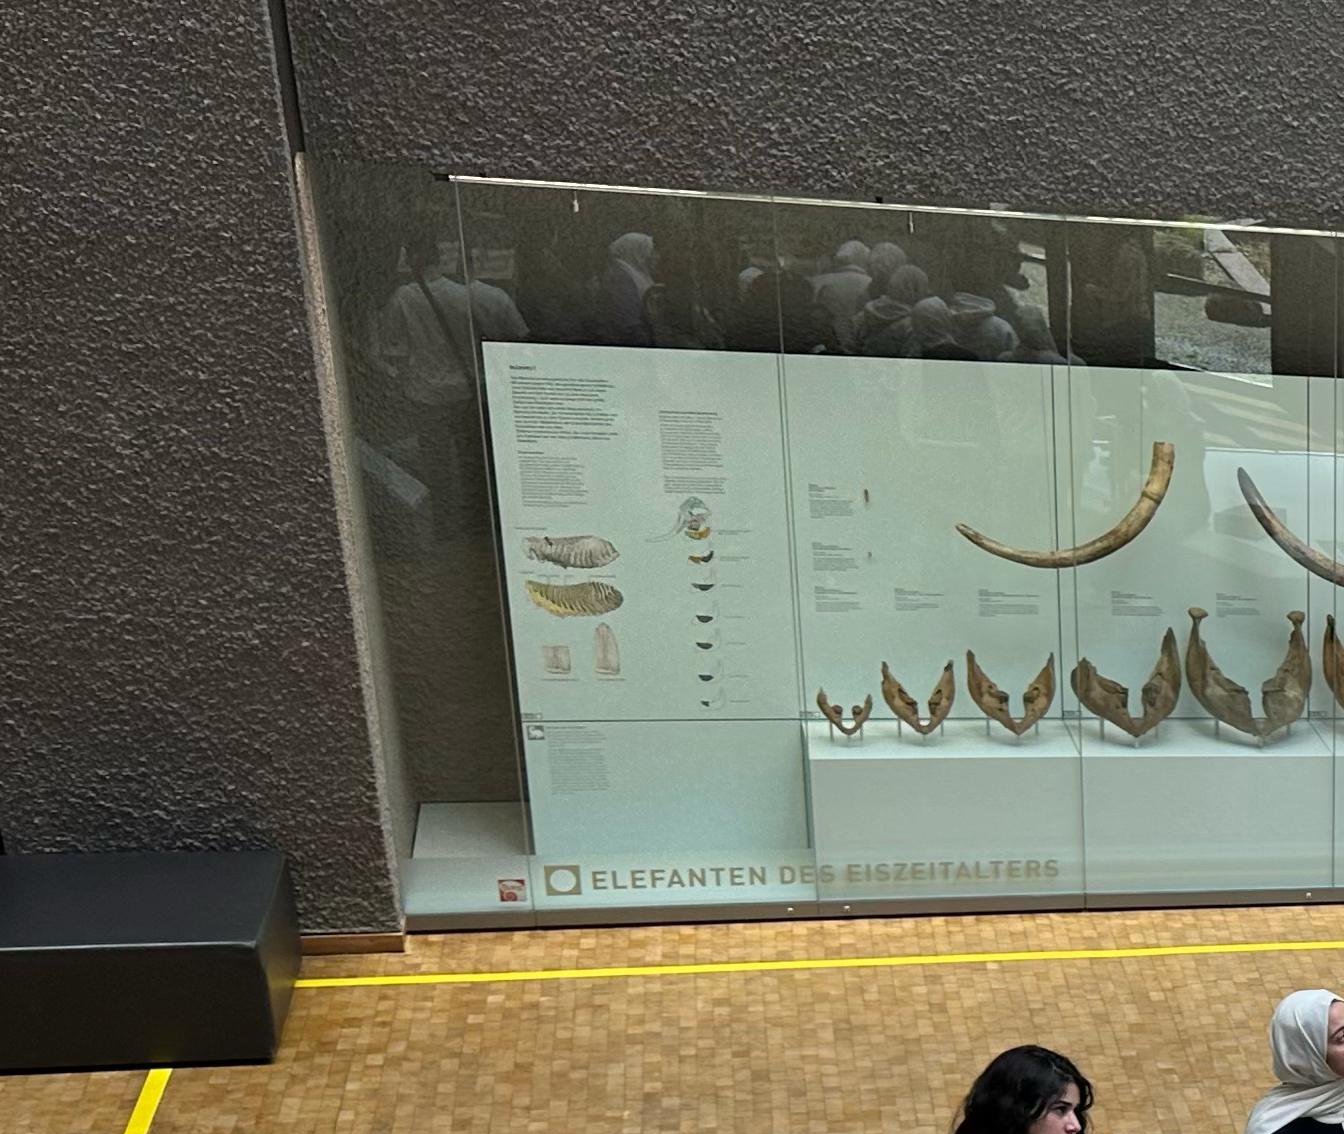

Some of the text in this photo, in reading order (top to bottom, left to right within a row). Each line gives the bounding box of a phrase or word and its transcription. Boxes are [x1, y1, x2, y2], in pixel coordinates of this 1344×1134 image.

[592, 860, 1060, 889] ELEFANTEN DES EISZEITALTERS
